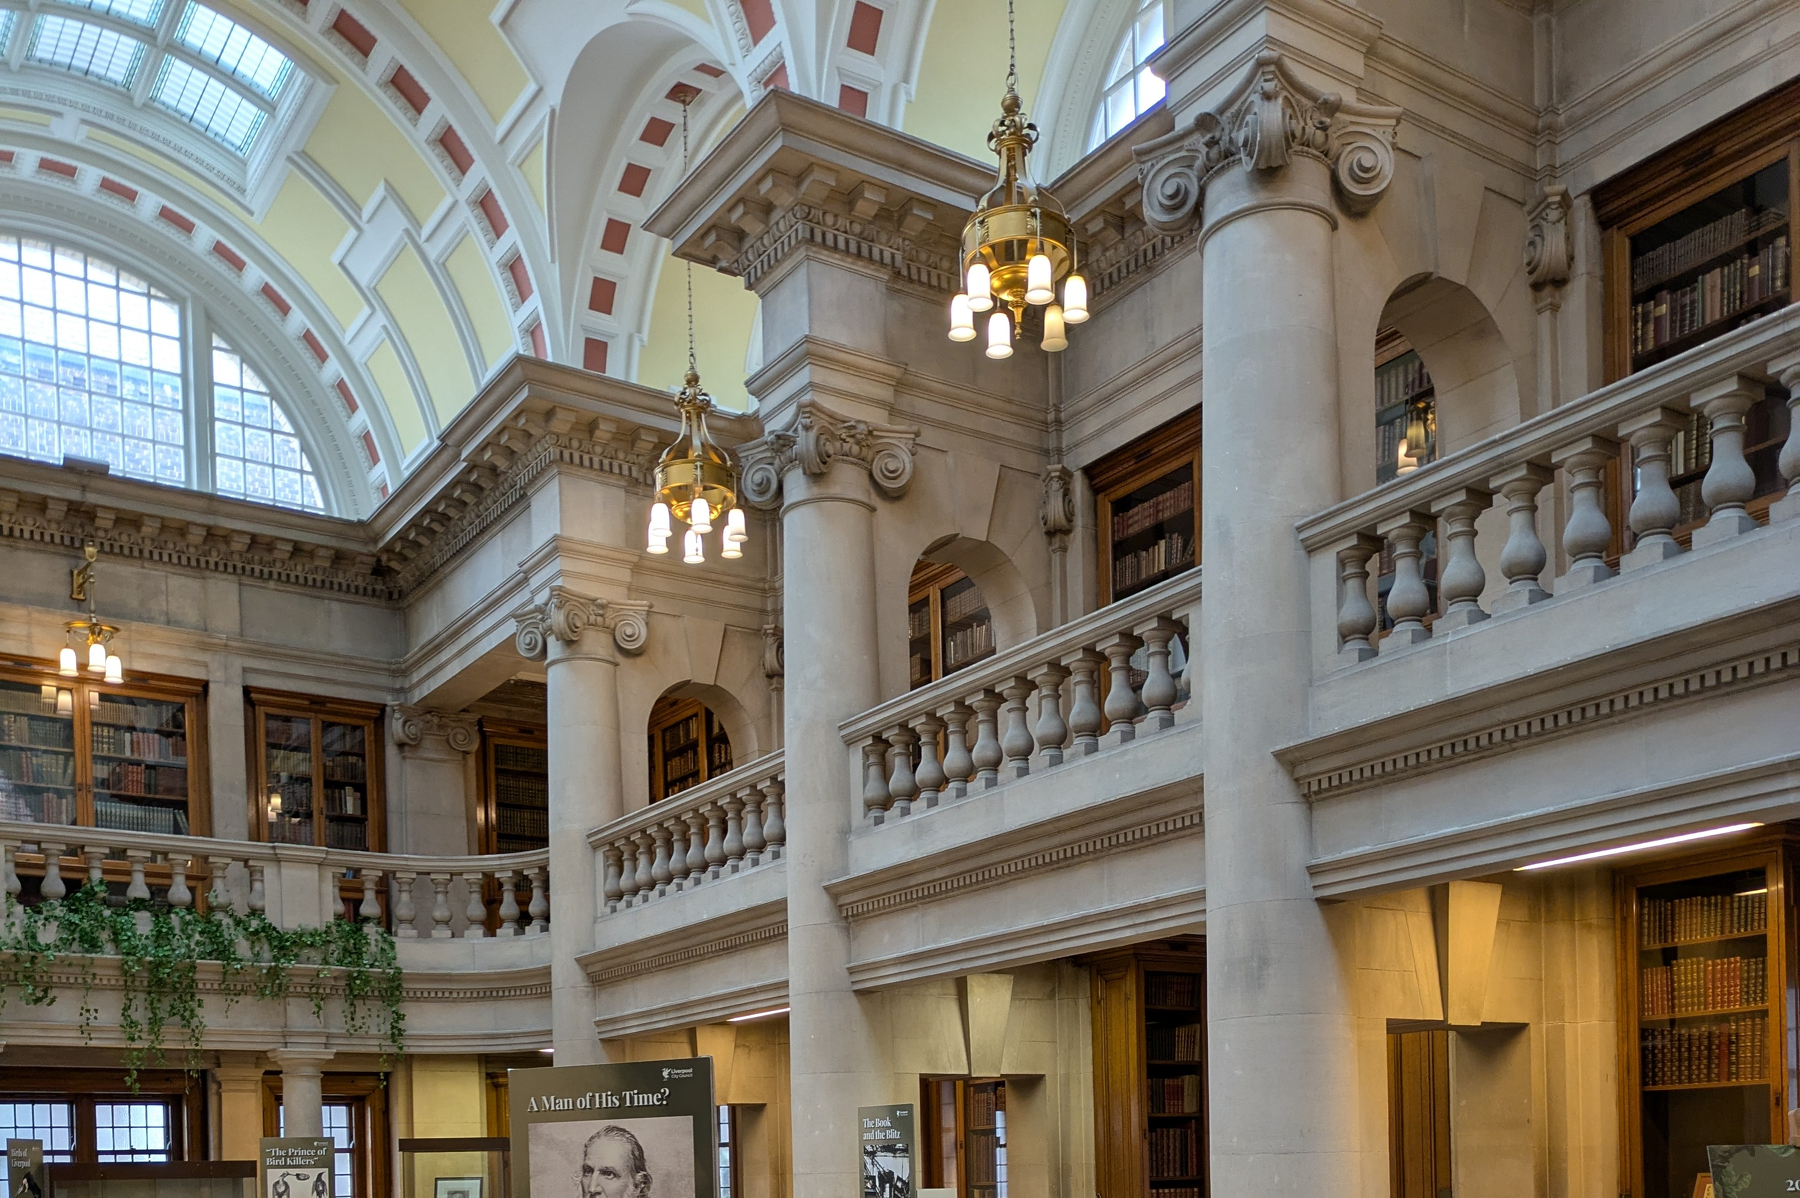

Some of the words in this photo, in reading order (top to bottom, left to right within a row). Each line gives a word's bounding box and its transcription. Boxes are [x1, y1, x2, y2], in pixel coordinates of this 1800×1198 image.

[528, 1098, 538, 1112] A
[541, 1096, 573, 1111] Man
[576, 1092, 592, 1108] of
[595, 1092, 620, 1108] His
[622, 1088, 670, 1107] Time?
[863, 1118, 874, 1128] The
[876, 1117, 892, 1127] Book
[863, 1130, 874, 1140] and
[875, 1130, 885, 1139] the
[886, 1129, 900, 1139] Blitz
